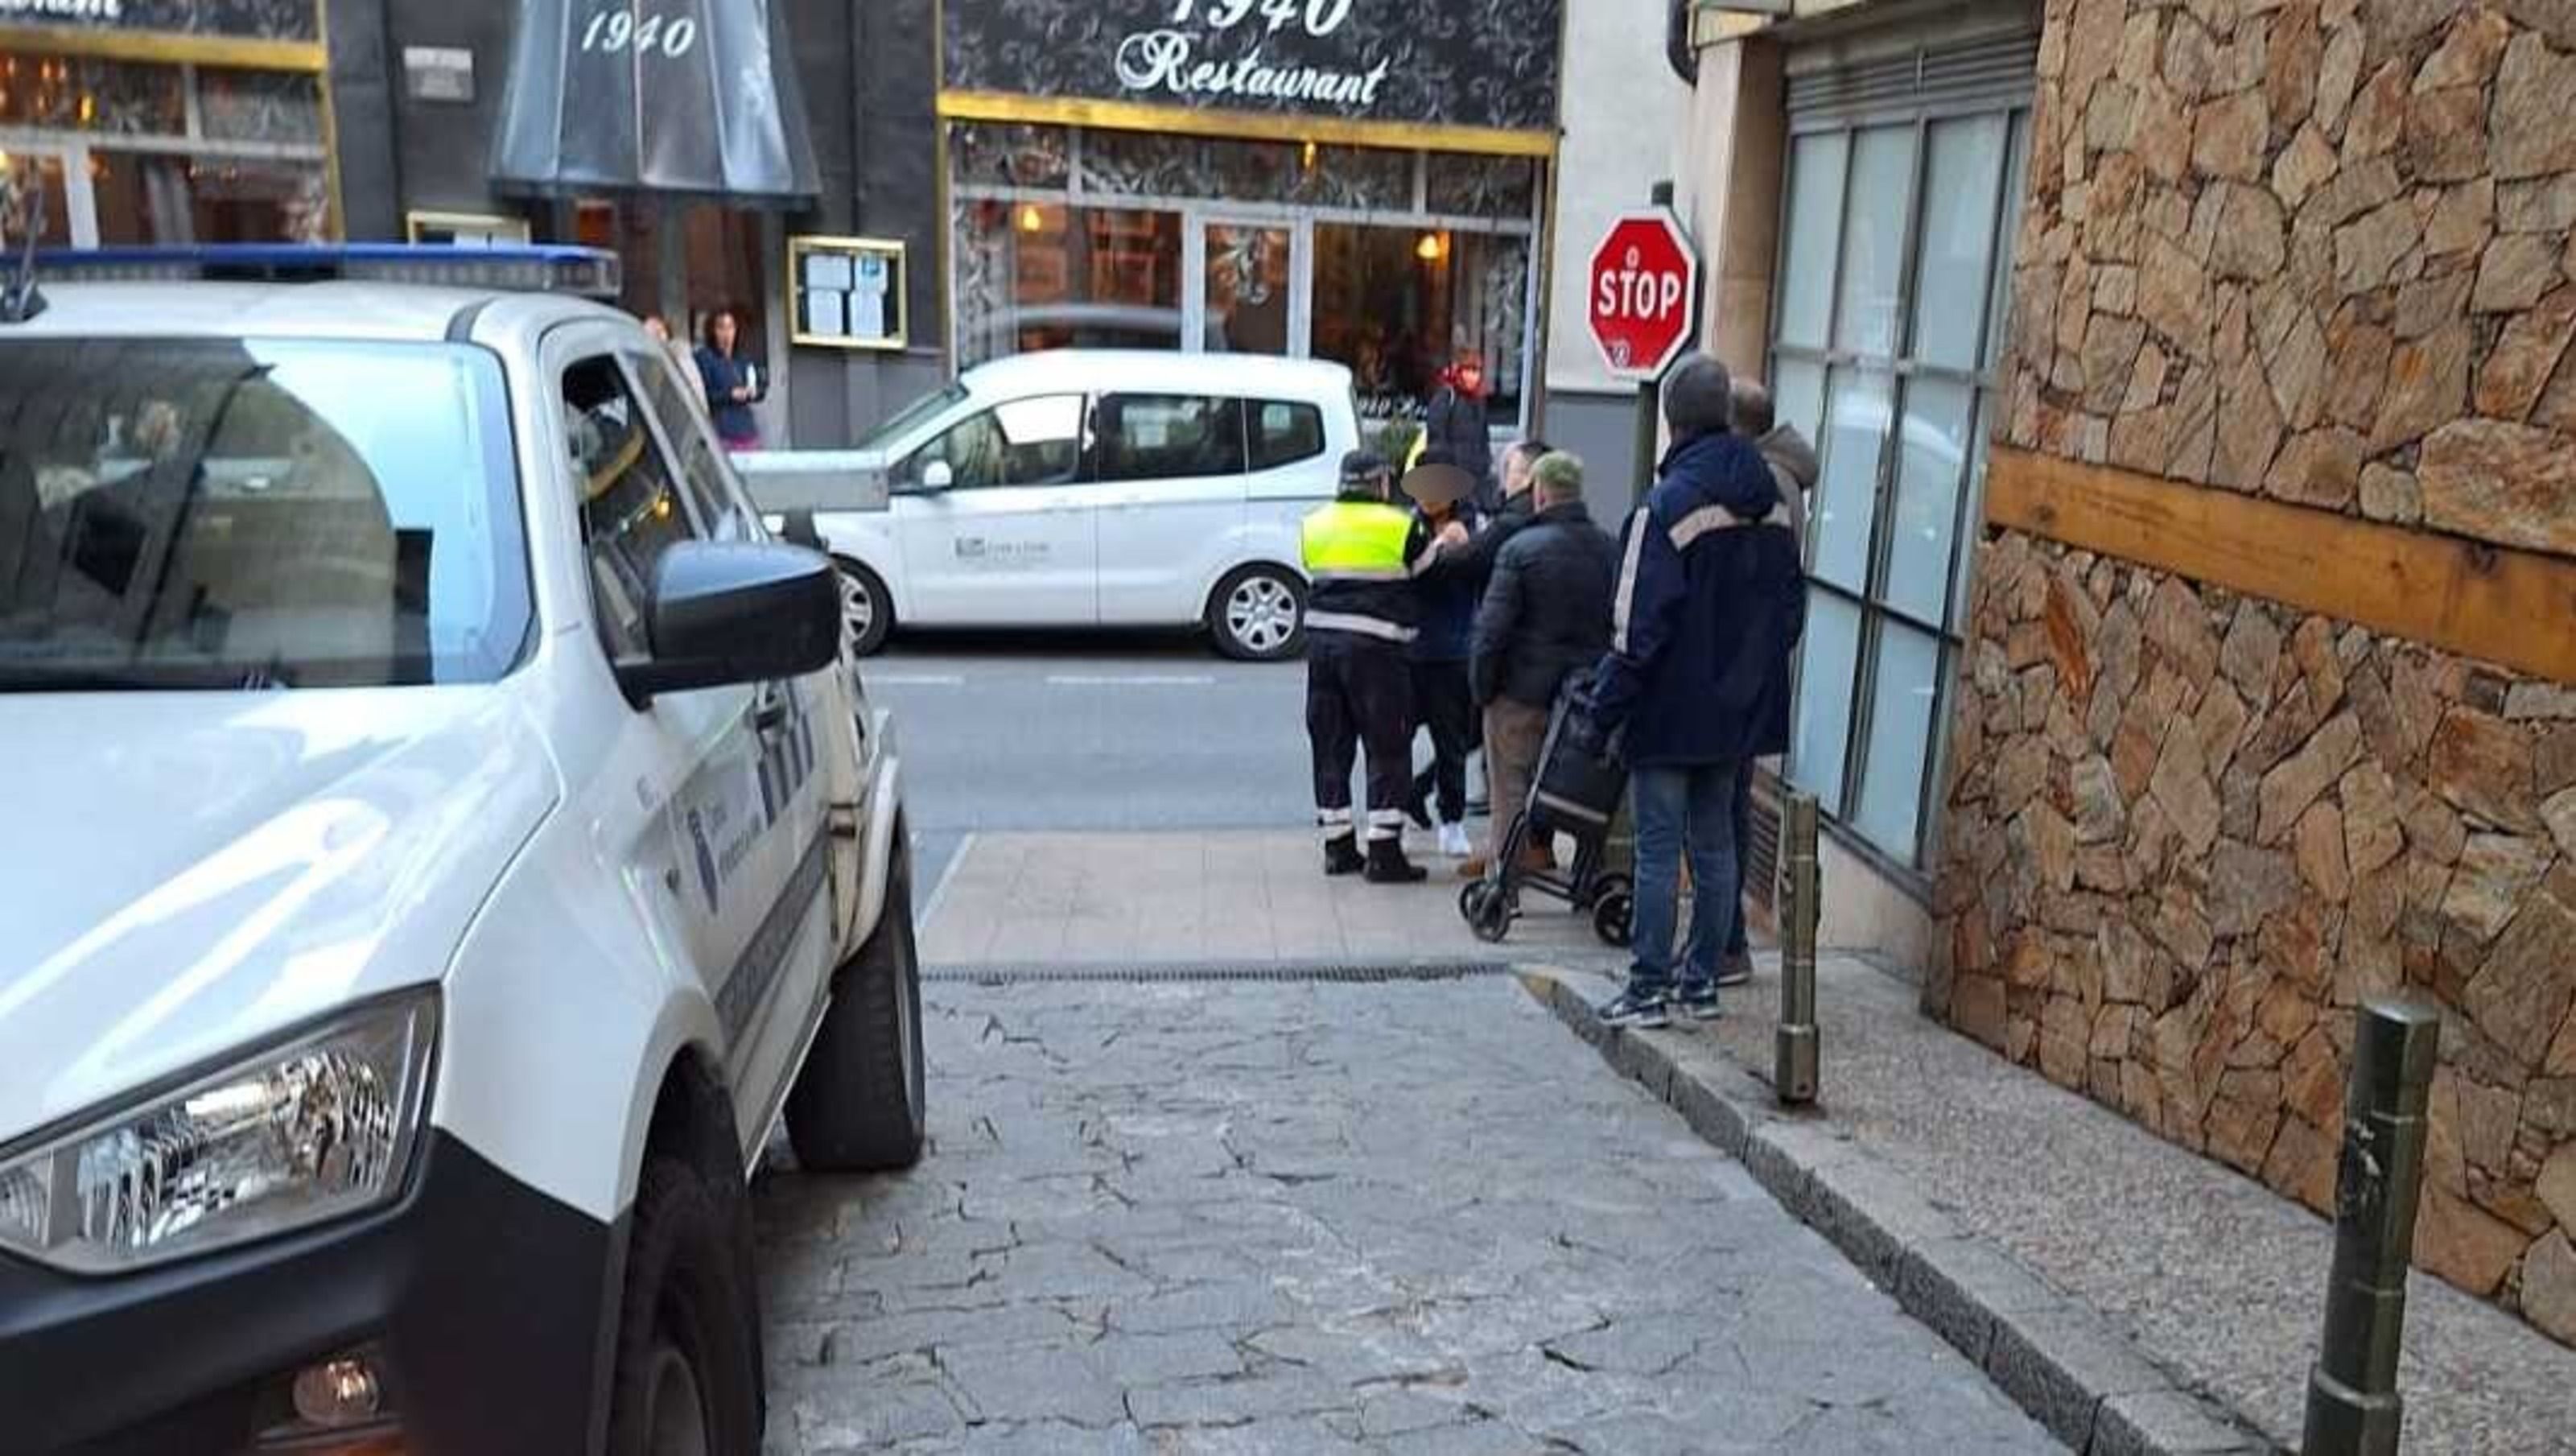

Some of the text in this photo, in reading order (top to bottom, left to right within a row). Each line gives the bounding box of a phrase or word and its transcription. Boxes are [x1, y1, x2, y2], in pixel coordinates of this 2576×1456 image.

[581, 10, 695, 59] 1940
[1115, 29, 1390, 104] Restaurant
[1597, 269, 1682, 320] STOP
